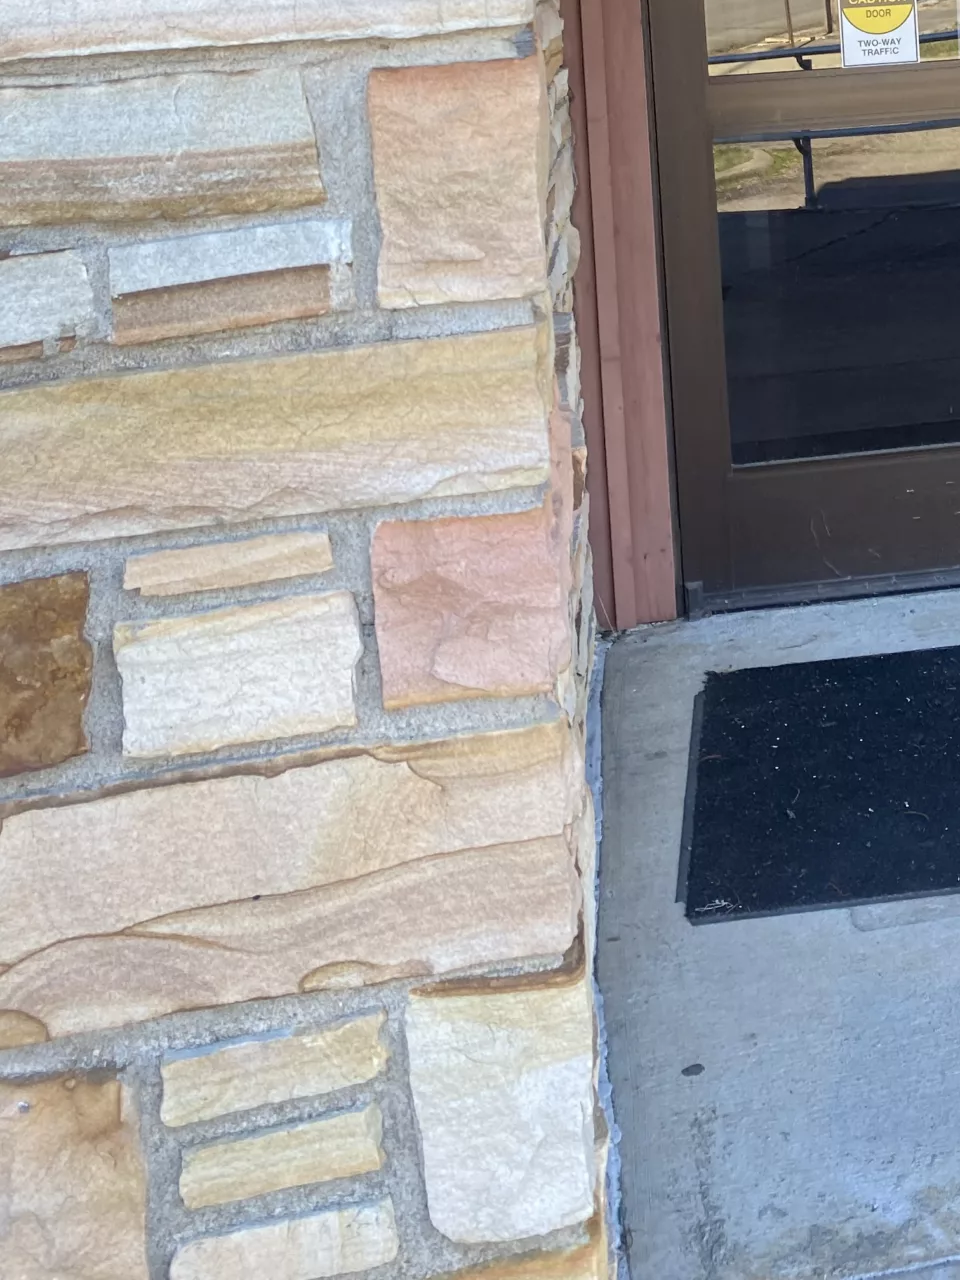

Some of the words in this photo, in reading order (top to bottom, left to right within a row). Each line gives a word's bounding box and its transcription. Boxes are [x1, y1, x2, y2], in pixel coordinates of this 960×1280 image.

[865, 8, 892, 18] DOOR
[858, 38, 901, 48] TWO-WAY
[862, 47, 899, 57] TRAFFIC
